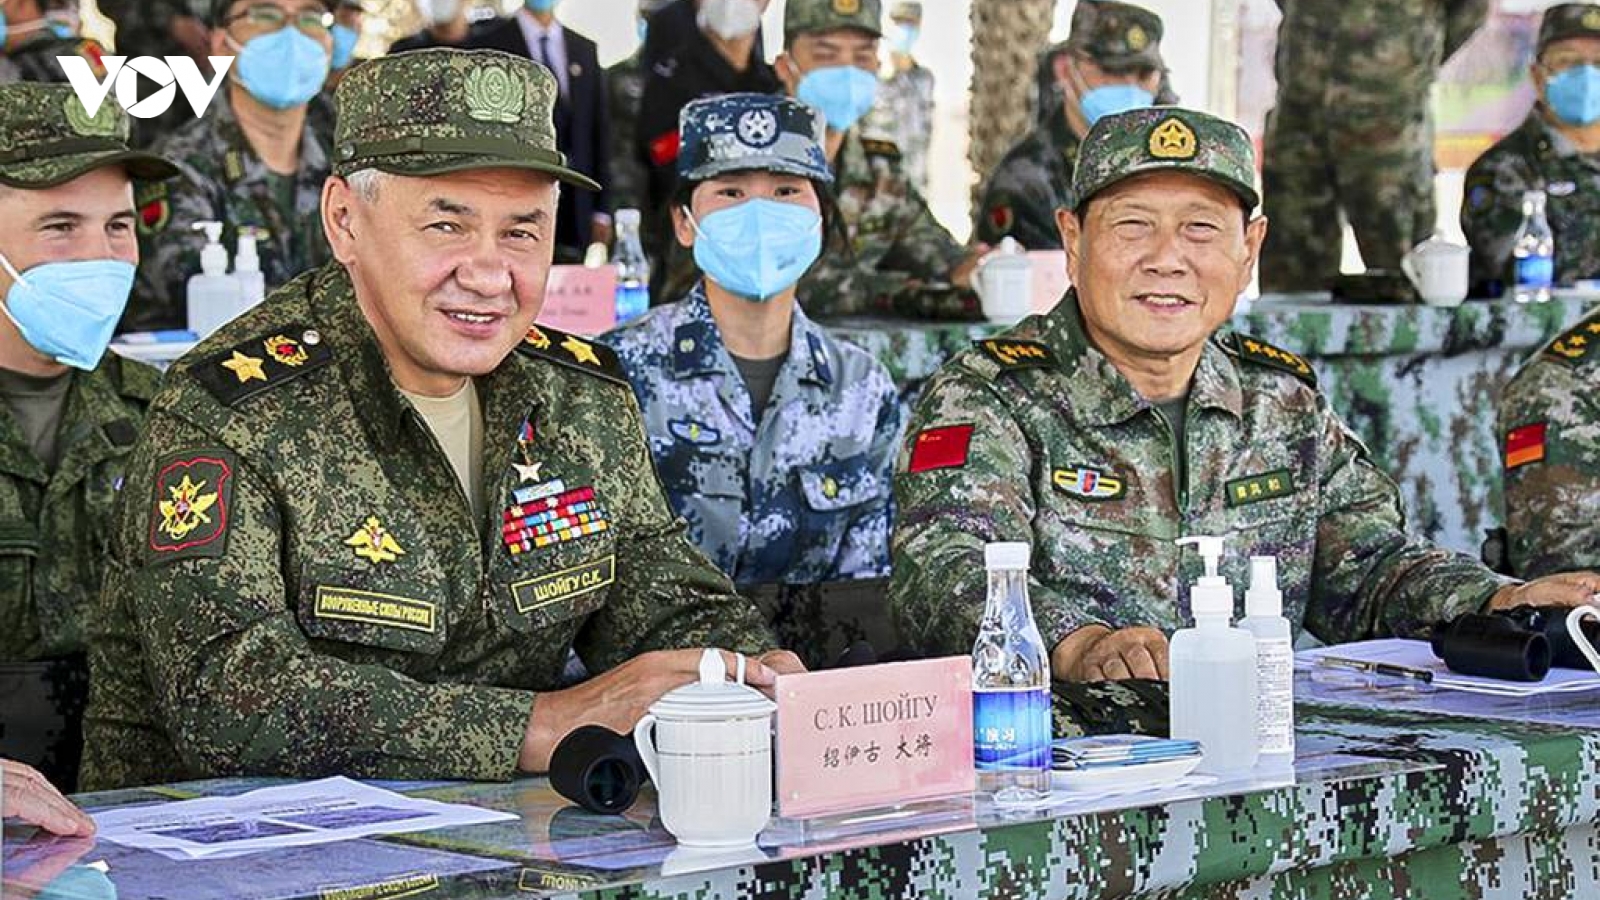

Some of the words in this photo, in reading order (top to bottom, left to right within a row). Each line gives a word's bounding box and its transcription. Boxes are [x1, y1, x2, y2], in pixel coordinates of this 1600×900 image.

[533, 575, 581, 601] ШОЙГУ
[814, 708, 833, 730] С.
[838, 705, 857, 727] К.
[863, 693, 938, 724] ШОЙГУ
